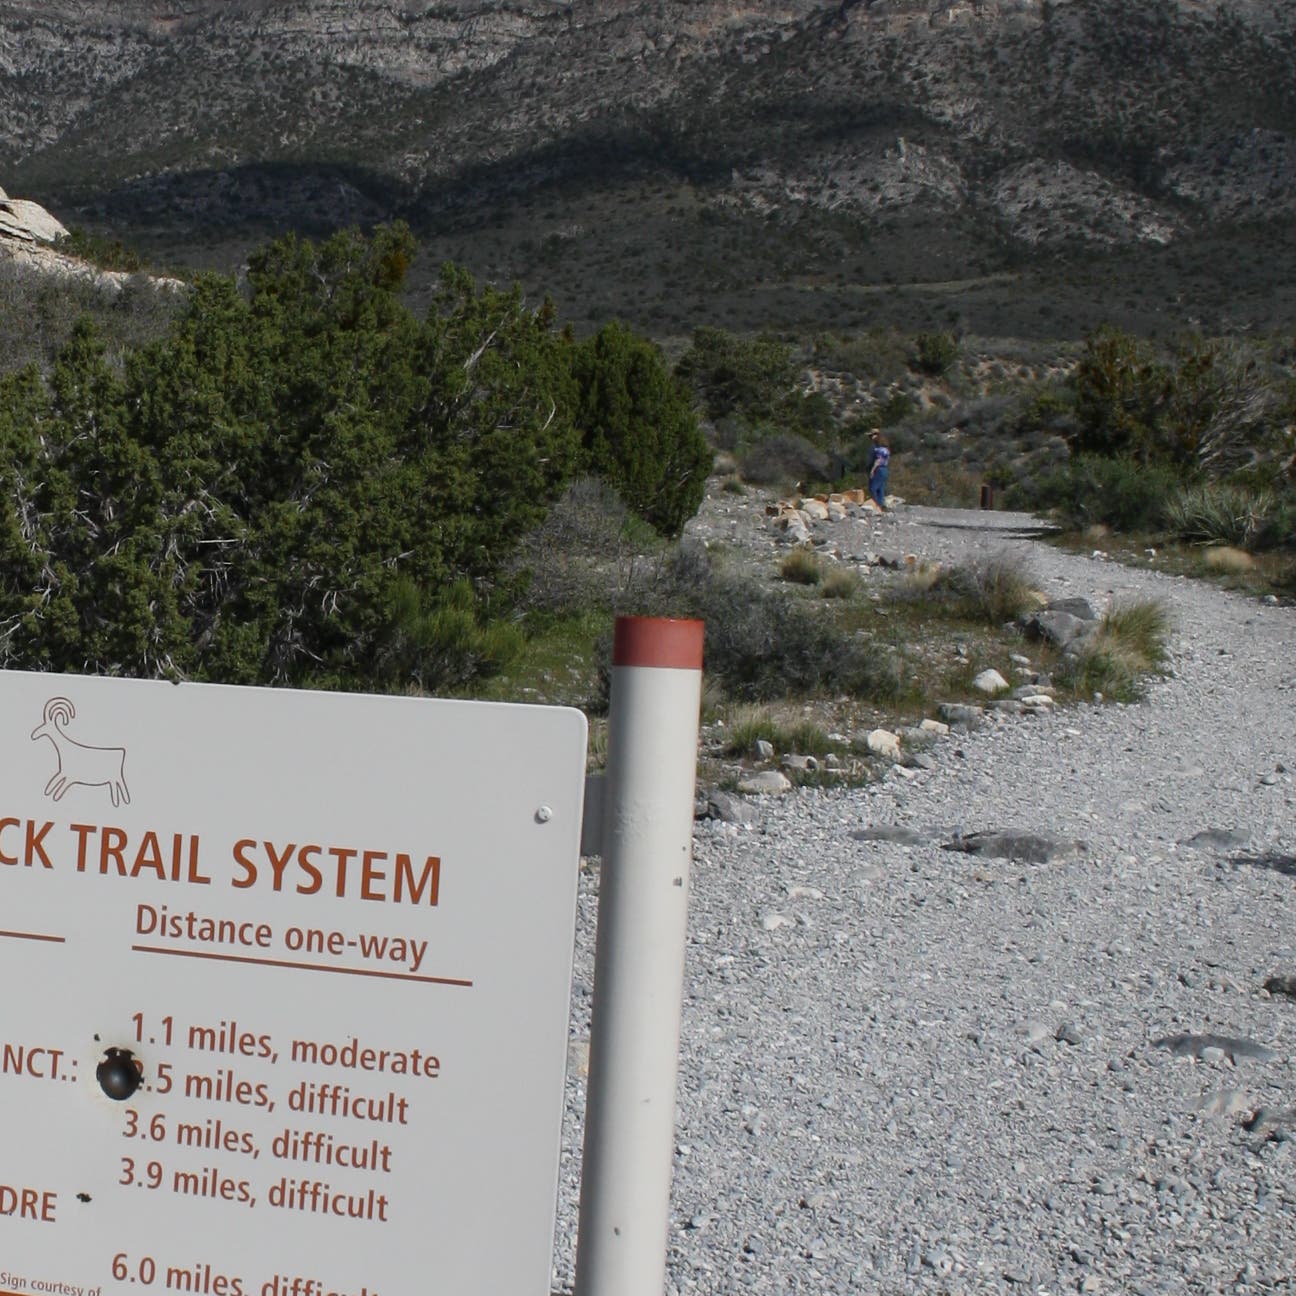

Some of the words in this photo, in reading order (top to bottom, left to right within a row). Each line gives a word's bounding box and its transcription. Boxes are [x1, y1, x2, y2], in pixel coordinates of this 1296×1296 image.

[70, 822, 211, 884] TRAIL
[232, 837, 441, 906] SYSTEM
[137, 903, 273, 947] Distance
[285, 927, 429, 971] one-way
[133, 1011, 174, 1045] 1.1
[188, 1020, 277, 1062] miles,
[291, 1039, 441, 1078] moderate
[185, 1068, 274, 1111] miles,
[288, 1081, 408, 1124] difficult
[122, 1107, 167, 1141] 3.6
[177, 1119, 260, 1158] miles,
[272, 1128, 391, 1172] difficult
[118, 1156, 164, 1189] 3.9
[173, 1168, 256, 1206] miles,
[268, 1176, 388, 1222] difficult
[0, 1272, 26, 1289] Sign
[112, 1252, 157, 1285] 6.0
